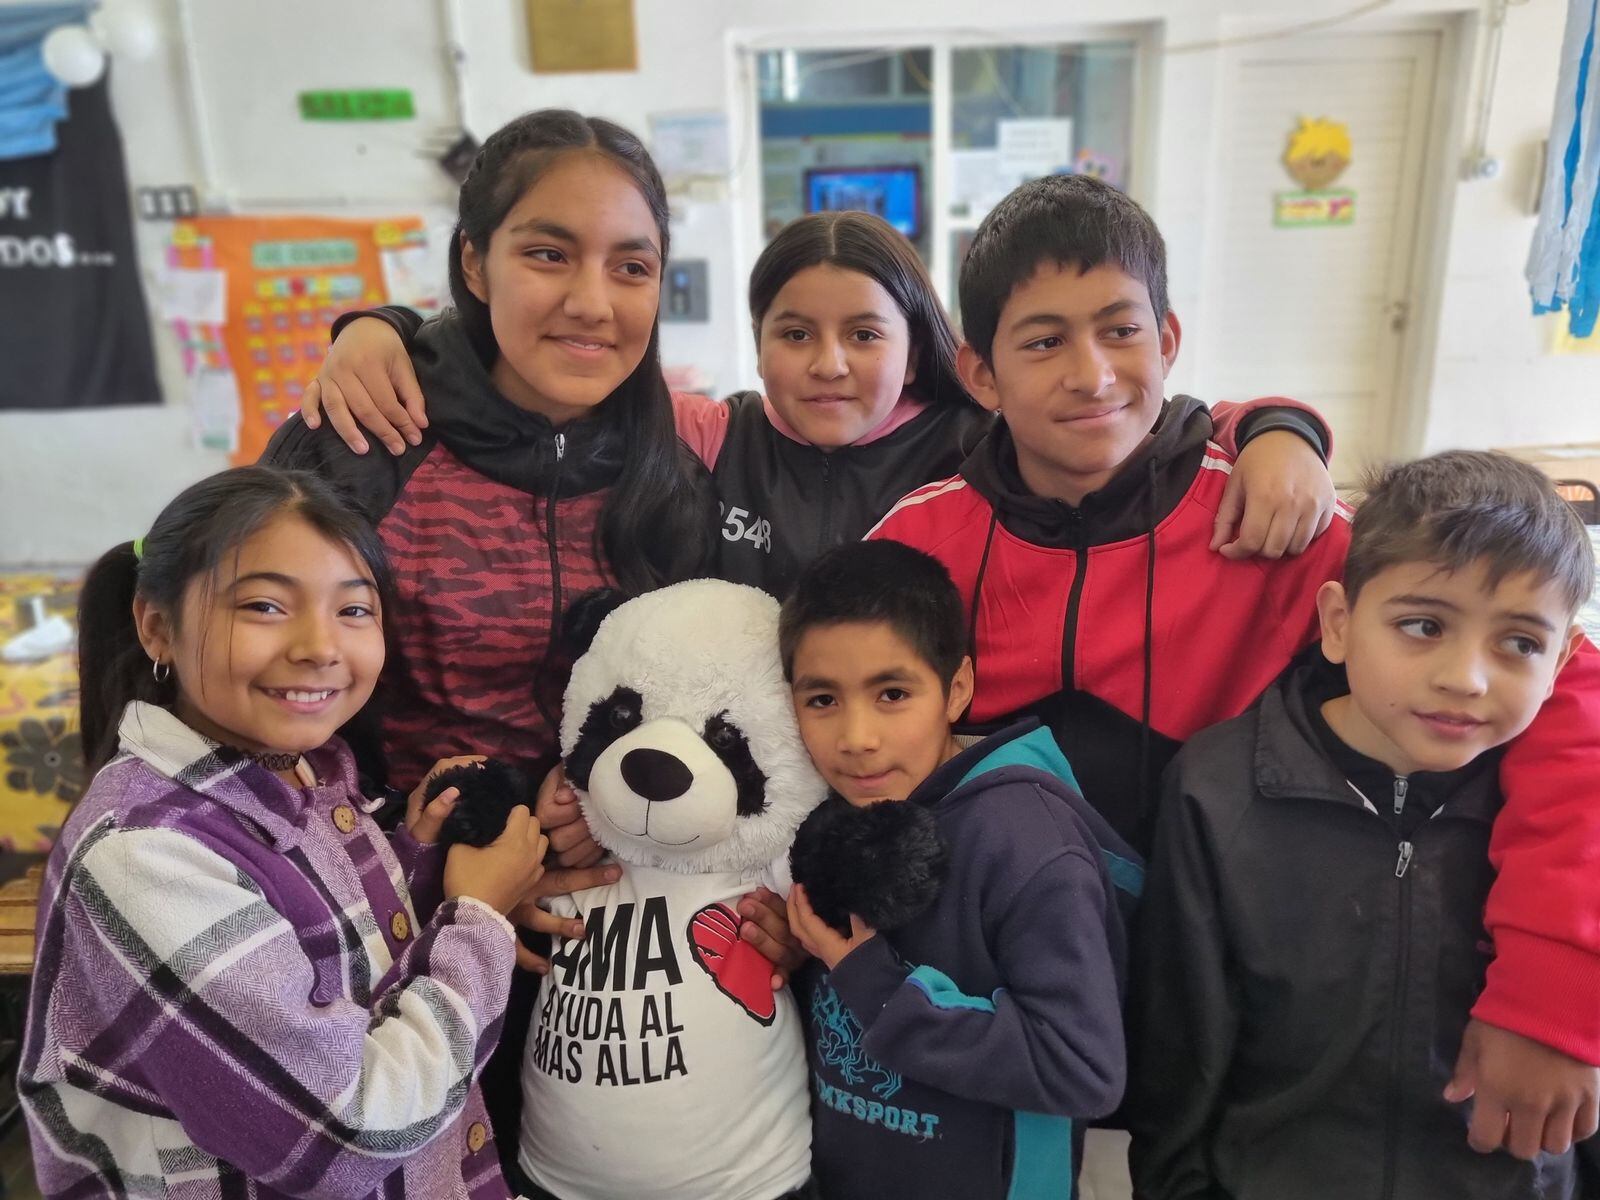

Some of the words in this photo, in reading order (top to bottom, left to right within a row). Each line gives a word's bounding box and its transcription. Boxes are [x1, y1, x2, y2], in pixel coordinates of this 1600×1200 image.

[541, 983, 627, 1042] AYUDA
[639, 991, 685, 1039] AL
[533, 1024, 583, 1084] MAS
[595, 1035, 689, 1087] ALLA
